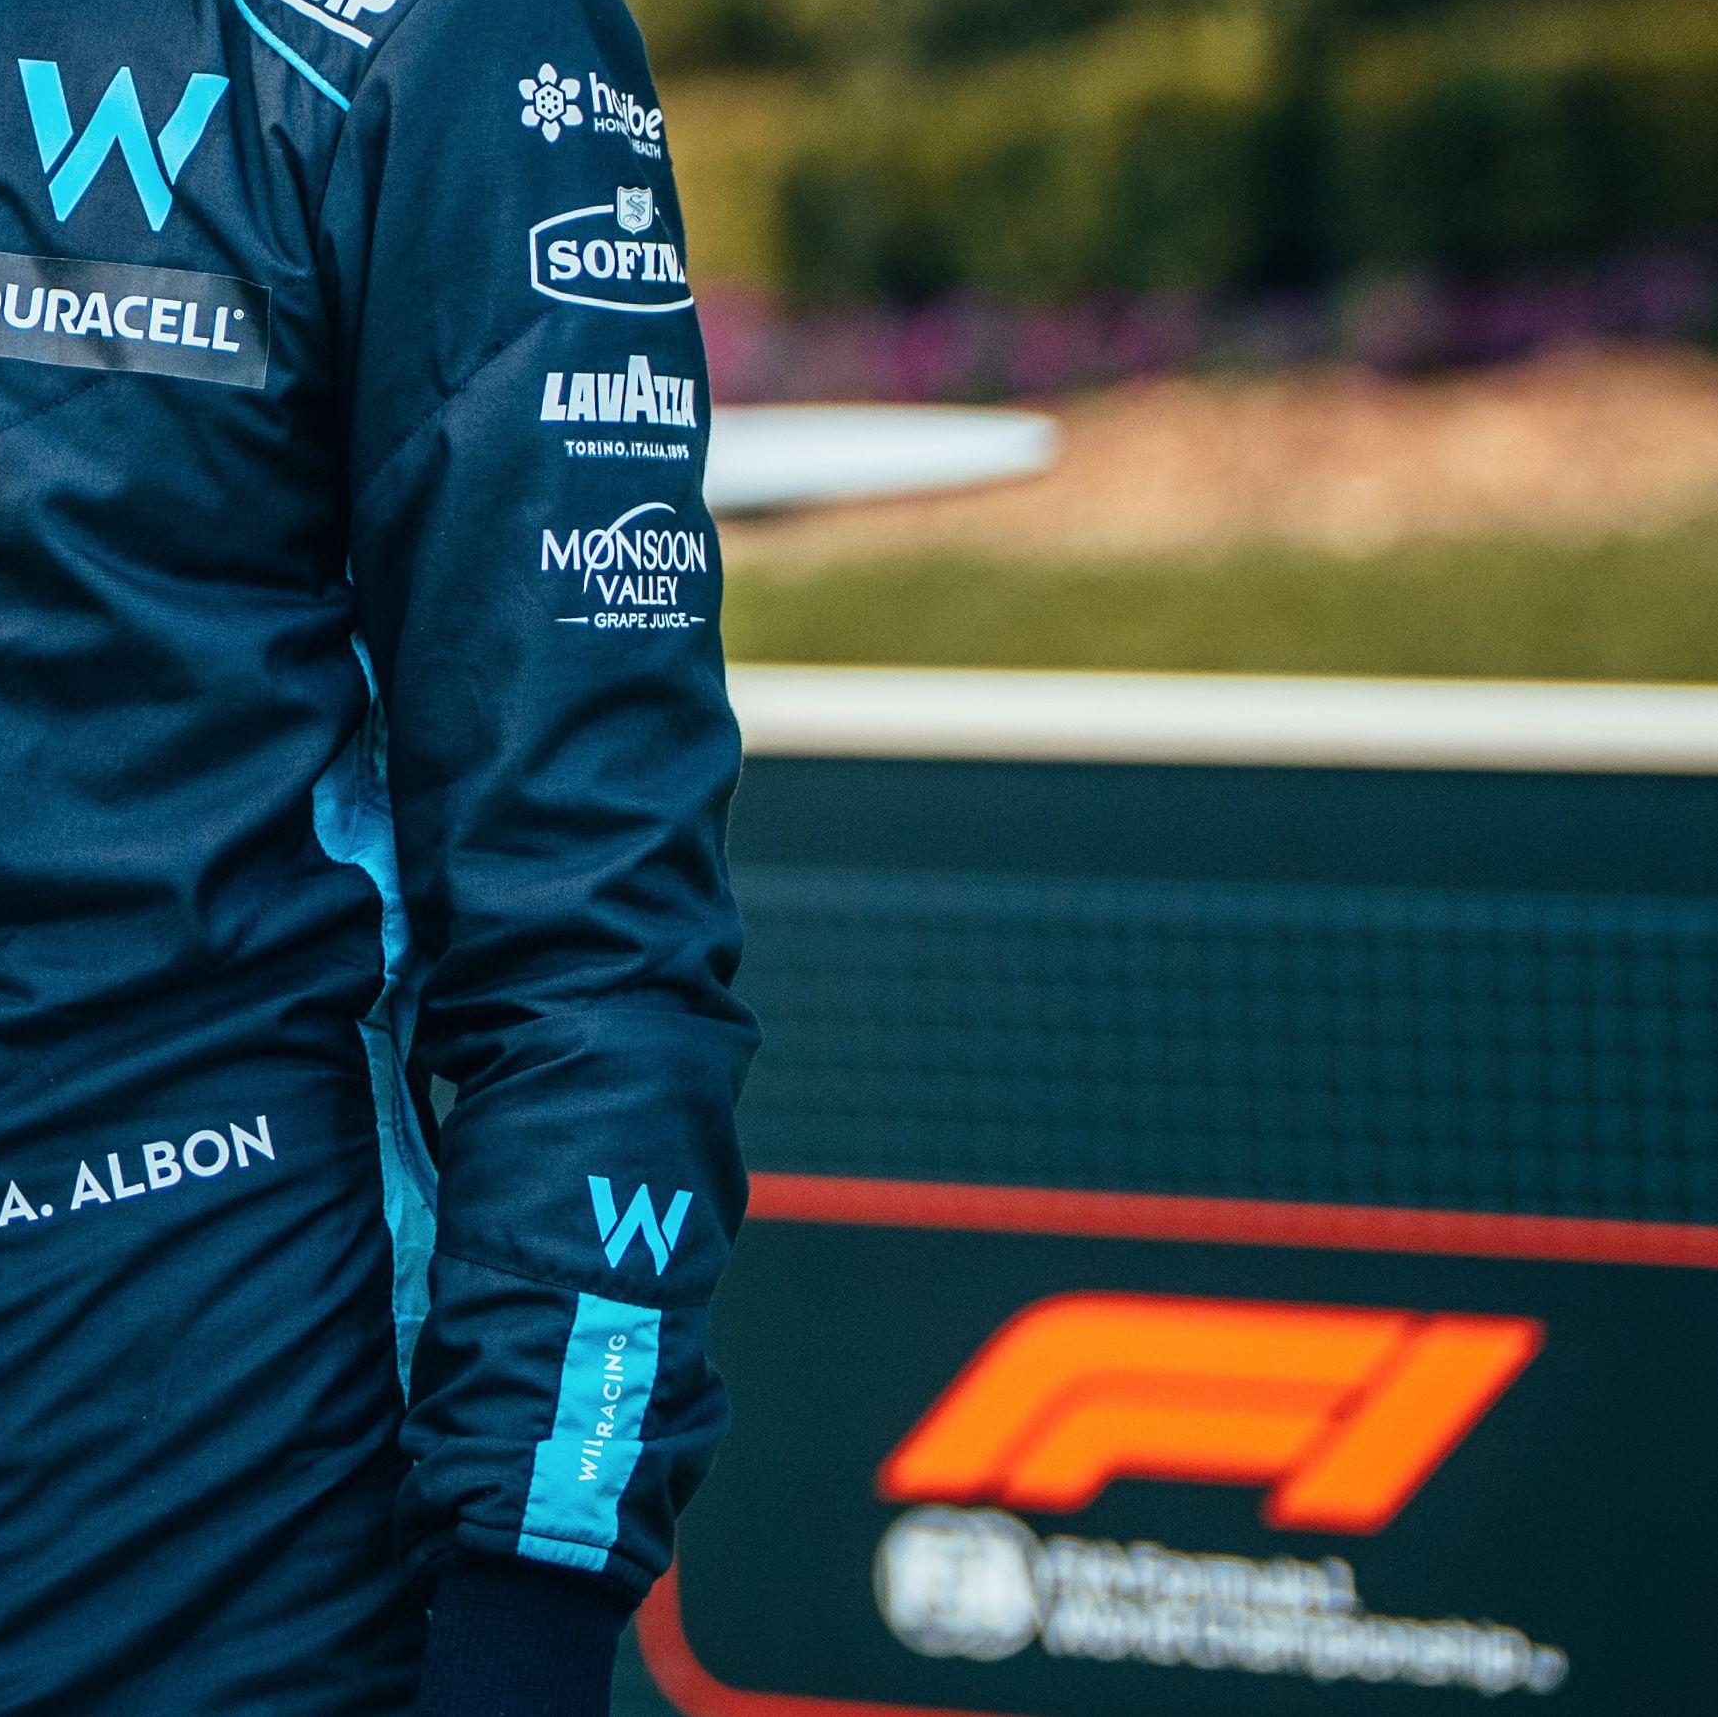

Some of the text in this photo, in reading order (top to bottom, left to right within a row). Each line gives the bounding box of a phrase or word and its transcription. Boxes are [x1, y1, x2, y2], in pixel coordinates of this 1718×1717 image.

[540, 354, 697, 429] LAVAZZA
[565, 440, 630, 458] TORINO,
[595, 574, 679, 606] VALLEY
[594, 612, 690, 629] GRAPE JUICE
[70, 1114, 276, 1211] ALBON
[595, 1333, 628, 1439] RACING
